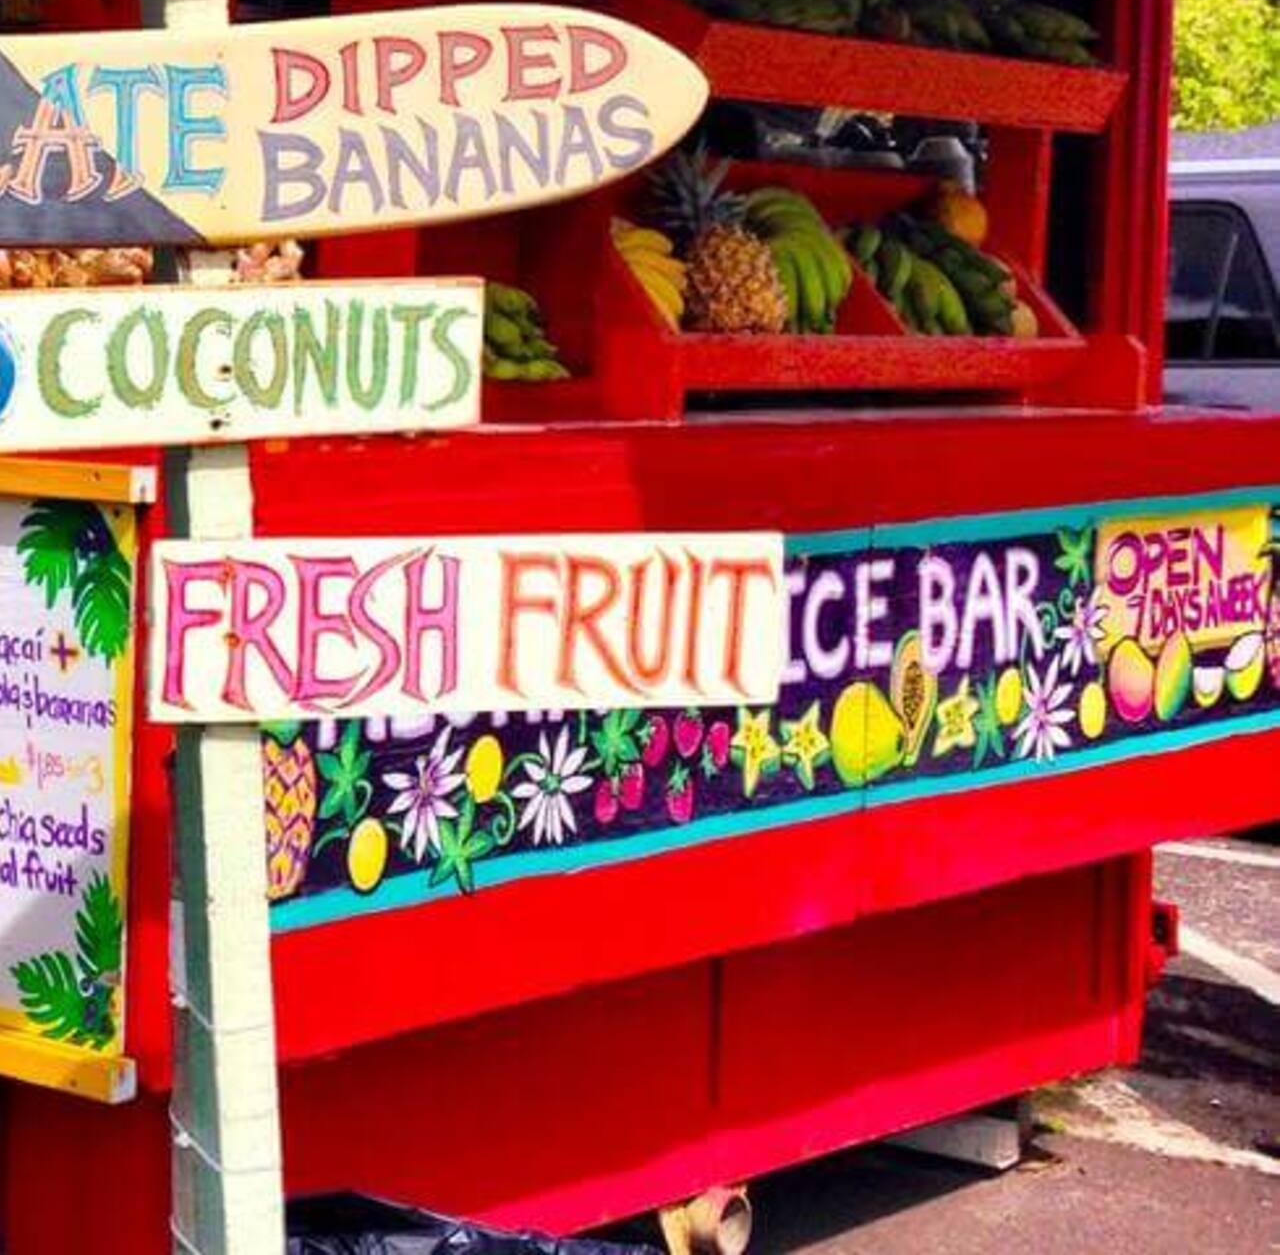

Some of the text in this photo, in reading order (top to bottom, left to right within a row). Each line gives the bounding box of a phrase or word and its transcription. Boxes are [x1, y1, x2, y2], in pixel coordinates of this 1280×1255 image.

[268, 21, 630, 125] DIPPED
[258, 93, 658, 225] BANANAS
[36, 297, 474, 421] COCONUTS
[919, 545, 1046, 677] BAR
[1107, 524, 1224, 597] OPEN
[160, 545, 778, 715] FRESH FRUIT
[1126, 593, 1146, 641] 7
[1148, 587, 1203, 641] DAYS
[19, 847, 80, 897] fruit
[39, 803, 106, 857] seeds
